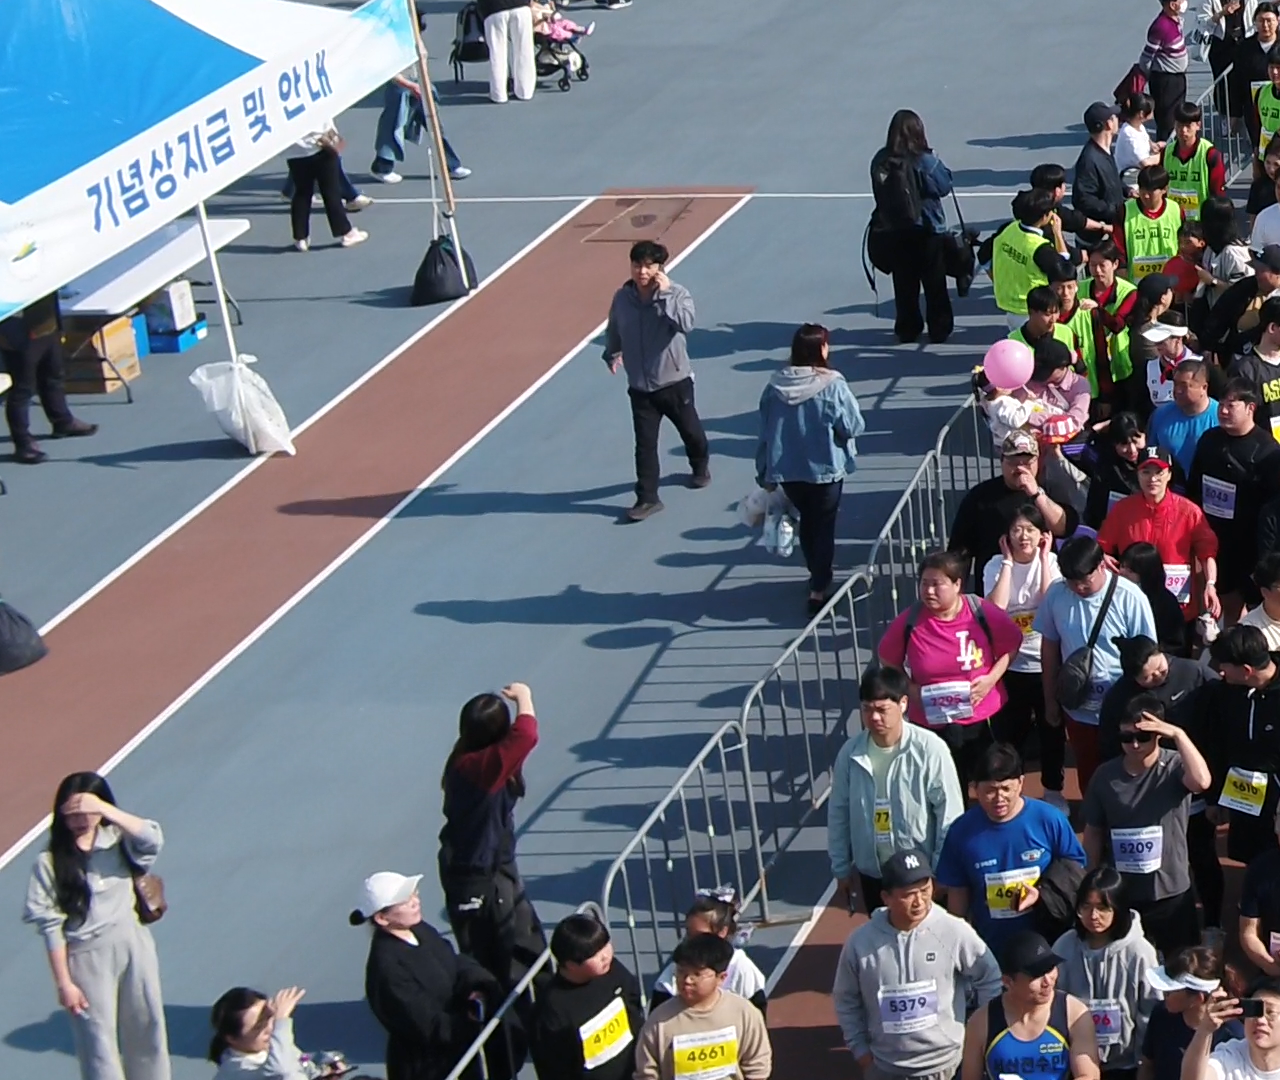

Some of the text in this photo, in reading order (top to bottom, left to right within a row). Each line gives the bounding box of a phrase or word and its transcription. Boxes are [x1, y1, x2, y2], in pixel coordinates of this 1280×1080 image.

[87, 50, 333, 232] 기념상지급 및 안내
[1120, 842, 1153, 854] 5209
[890, 997, 925, 1013] 5379
[594, 1018, 620, 1046] 4701
[687, 1046, 725, 1062] 4661
